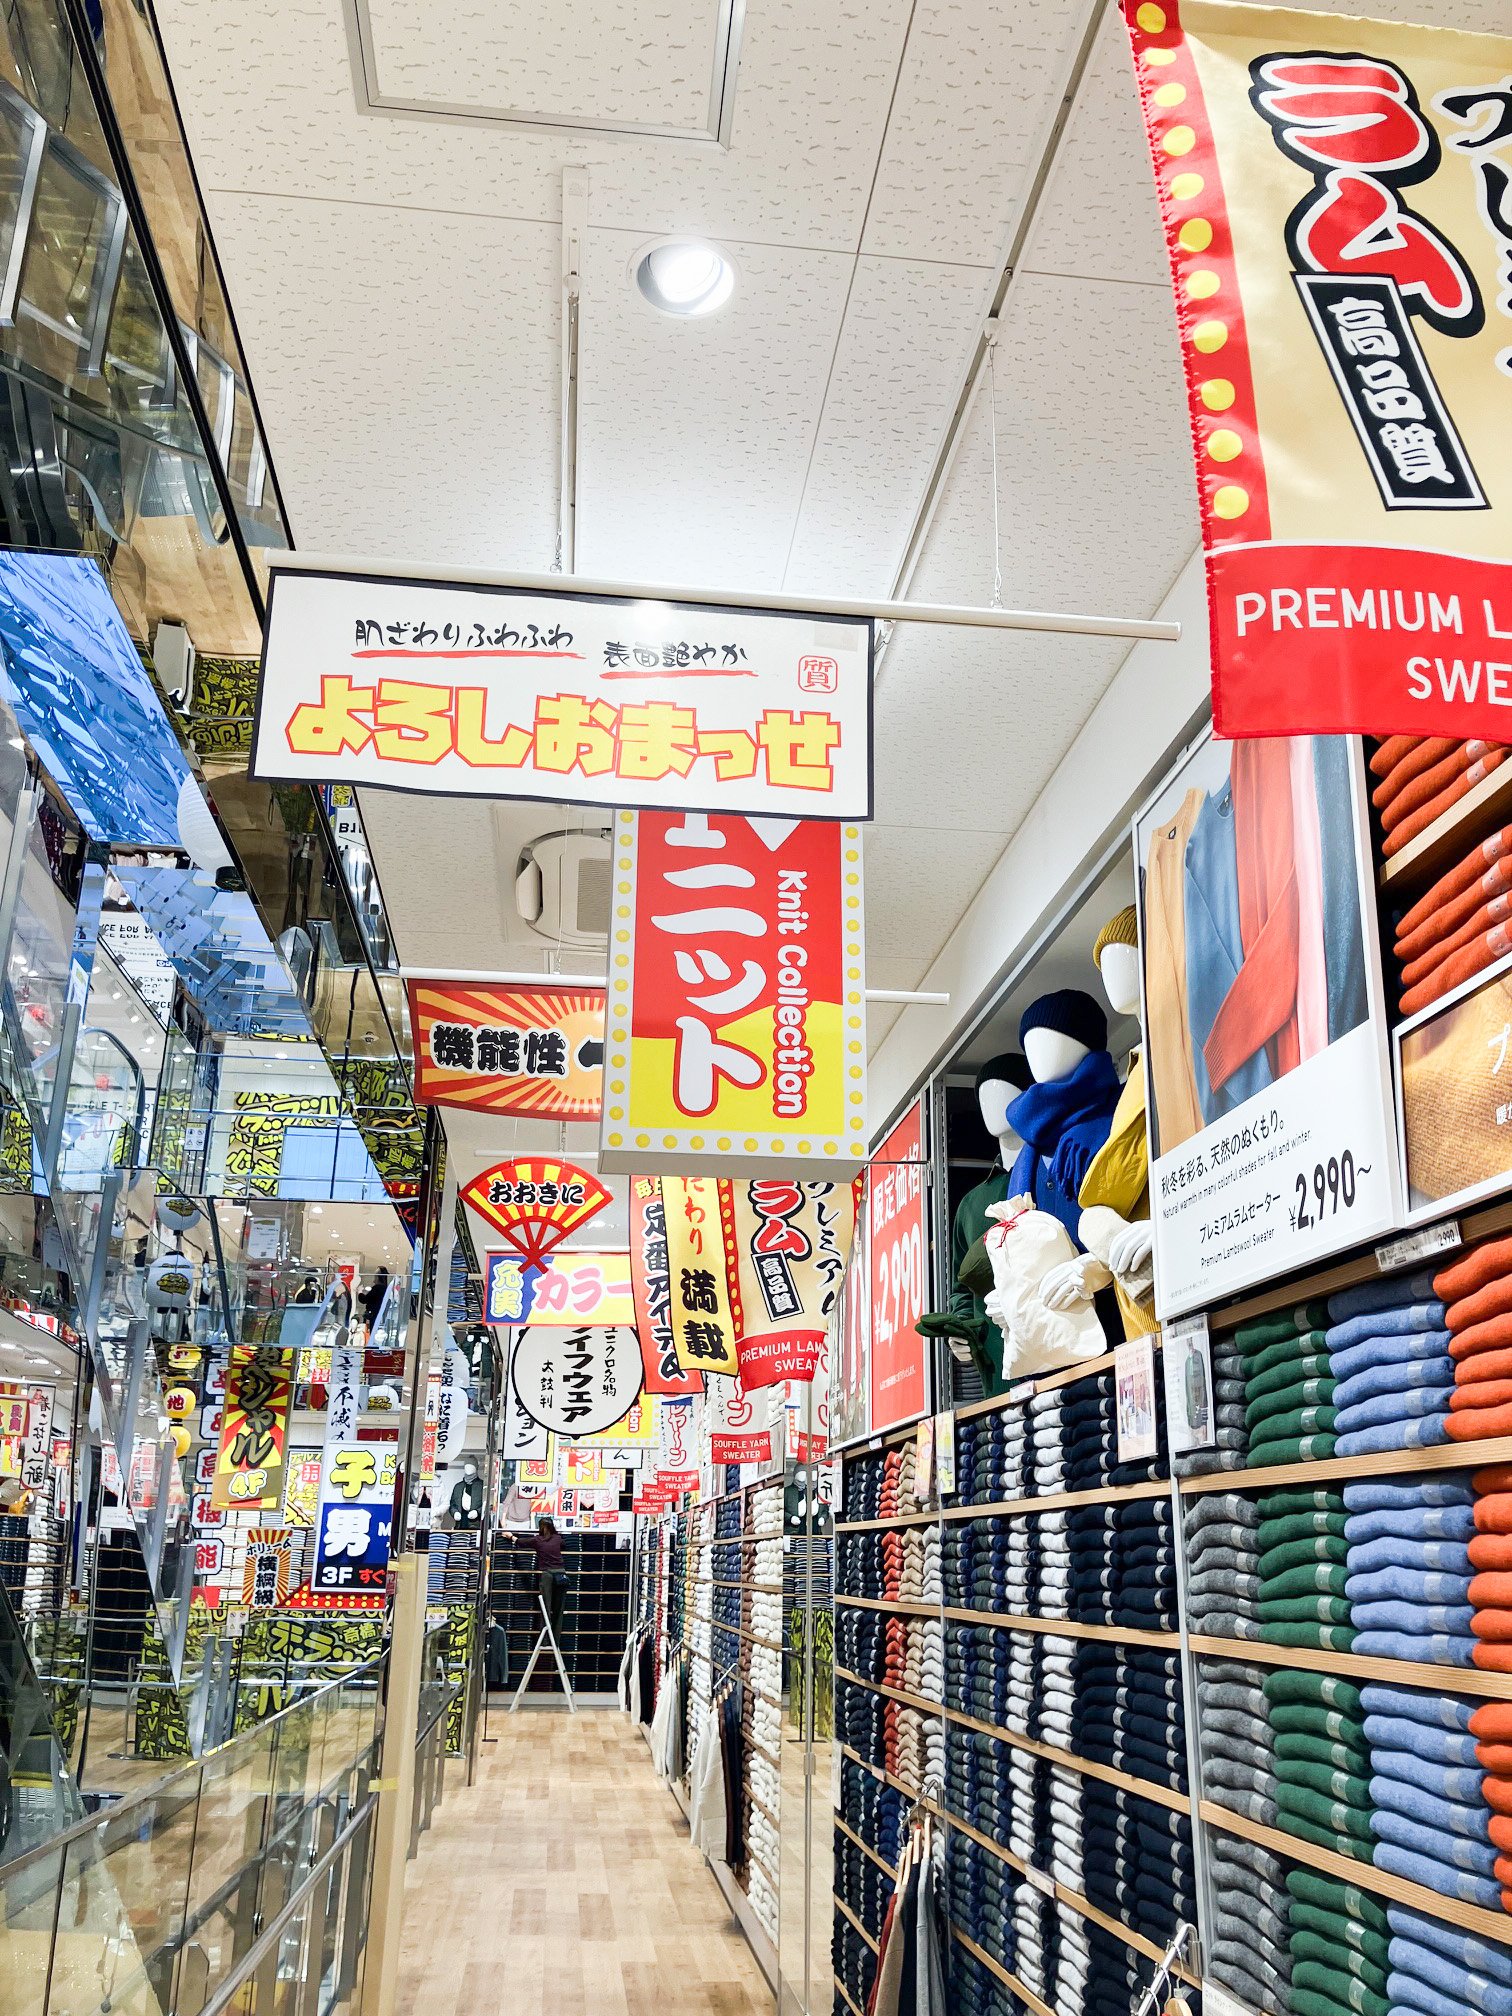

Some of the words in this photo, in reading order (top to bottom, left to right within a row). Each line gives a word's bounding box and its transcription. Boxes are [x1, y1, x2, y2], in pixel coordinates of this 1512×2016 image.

[1252, 53, 1480, 332] ラム
[1327, 297, 1455, 484] 高品質
[355, 619, 574, 649] 肌ざわりふわふわ
[1235, 587, 1464, 637] PREMIUM
[603, 641, 748, 669] 表面艶やか
[284, 673, 843, 793] よろしおまっせ
[777, 868, 808, 936] Knit
[772, 944, 810, 1118] Collection
[489, 1180, 585, 1206] おおきに
[873, 1142, 920, 1236] 限定価格
[750, 1180, 811, 1262] ラム
[535, 1266, 634, 1313] カラー
[646, 1203, 686, 1380] 定番アイテム
[760, 1258, 796, 1314] 高品質
[874, 1222, 922, 1347] ¥2,990
[680, 1268, 729, 1362] 満載
[601, 1326, 618, 1397] ユニクロ名物
[740, 1343, 791, 1364] PREMIUM
[540, 1360, 554, 1409] 太鼓判
[713, 1440, 746, 1449] SOUFFLE
[749, 1438, 769, 1448] YARN
[722, 1451, 760, 1460] SWEATER
[231, 1471, 266, 1498] 4F
[330, 1450, 377, 1499] 子
[247, 1538, 292, 1556] ボリューム
[323, 1508, 372, 1557] 男
[321, 1566, 354, 1585] 3F
